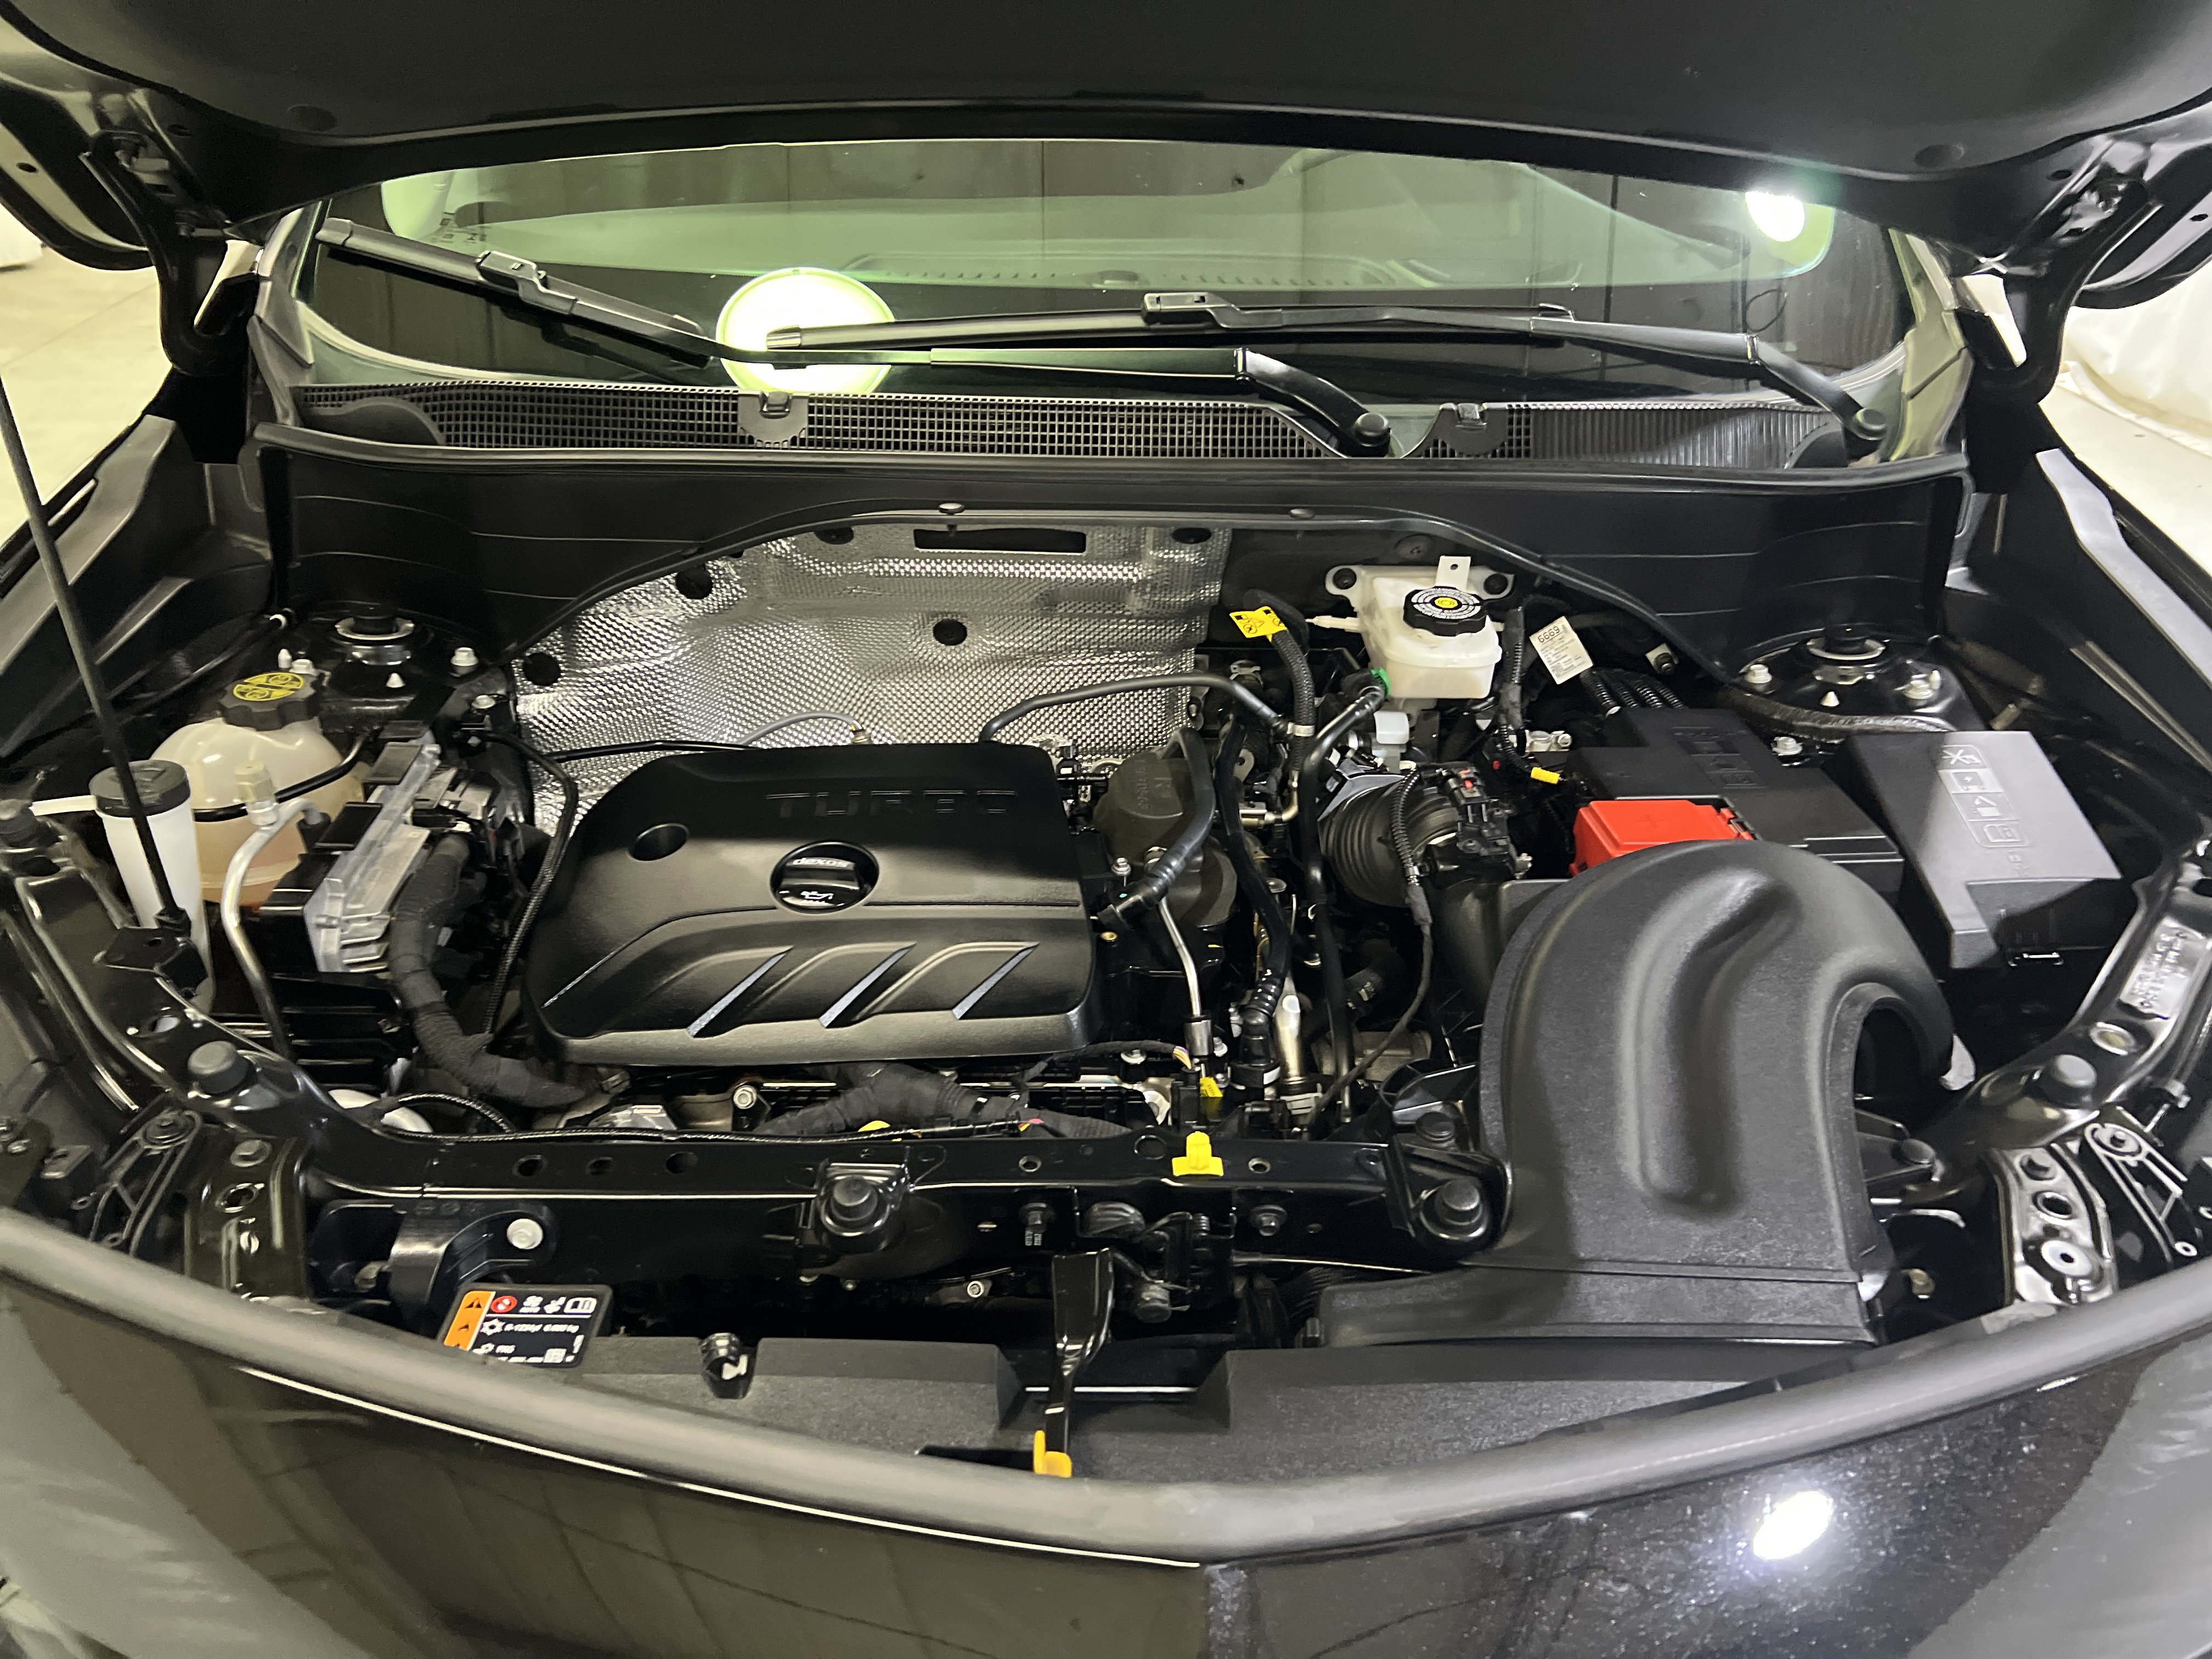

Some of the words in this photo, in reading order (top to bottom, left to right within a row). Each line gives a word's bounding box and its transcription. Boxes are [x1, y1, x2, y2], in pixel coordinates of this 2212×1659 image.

[1538, 625, 1560, 643] 6669
[766, 790, 1018, 819] TURBO
[793, 857, 849, 868] dexos
